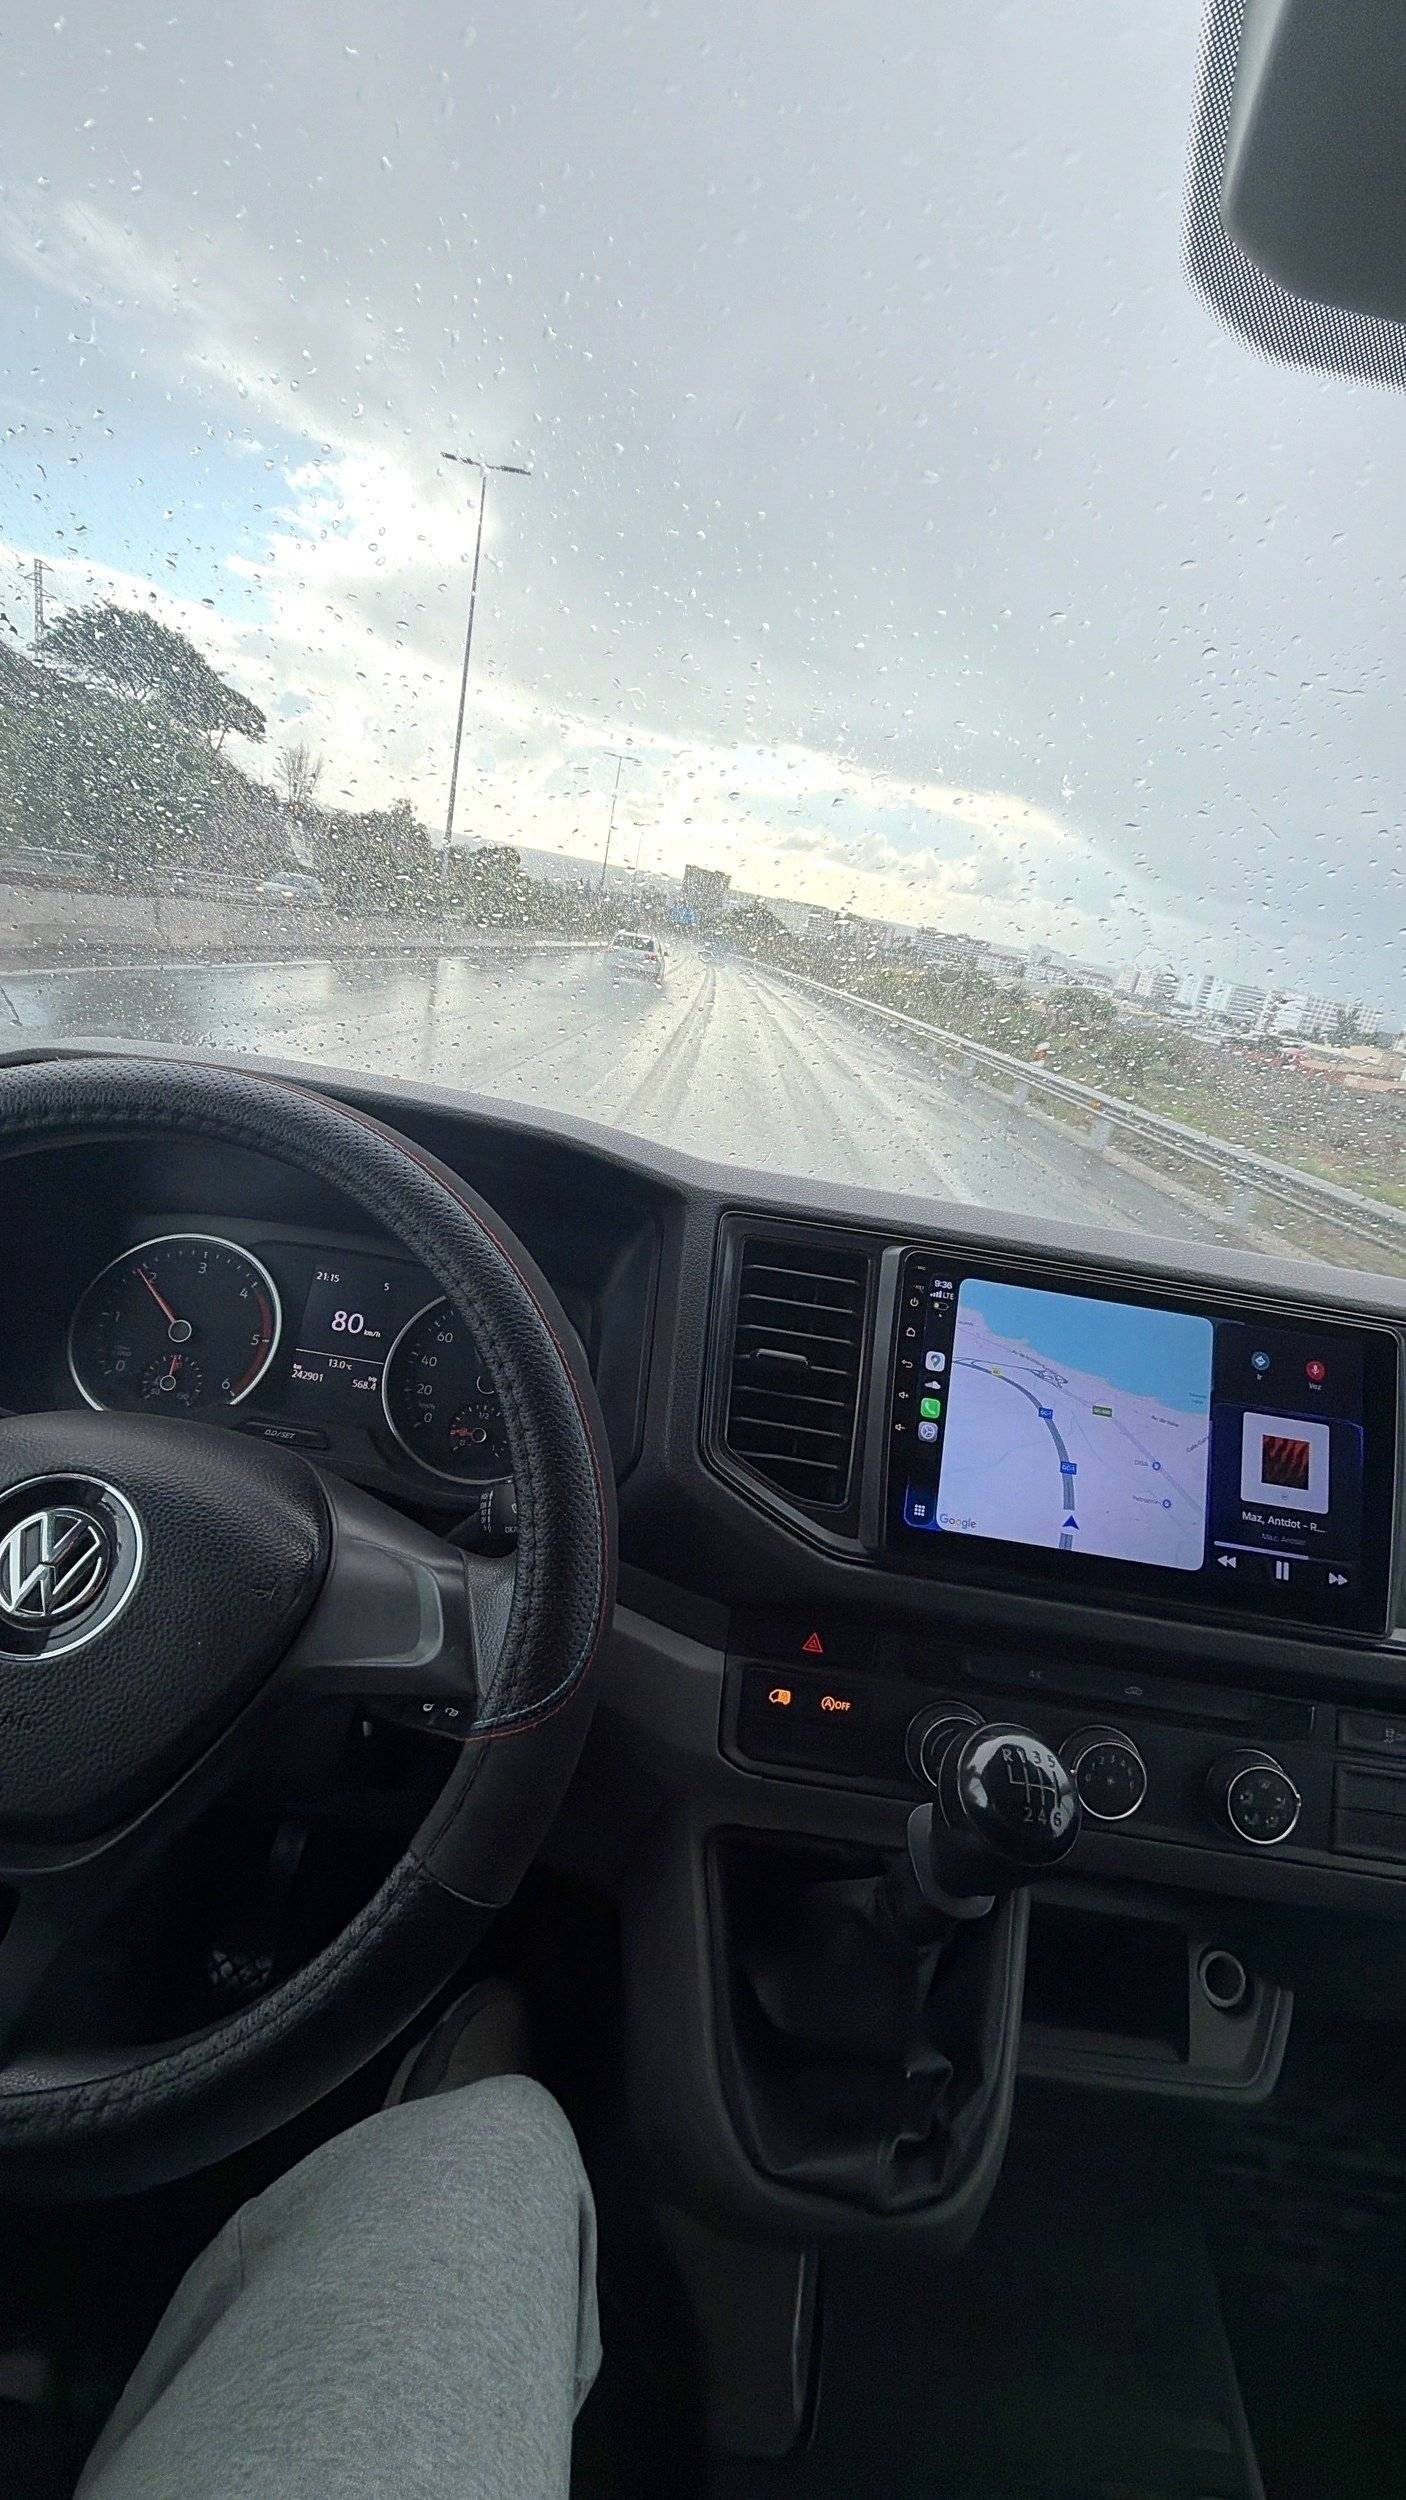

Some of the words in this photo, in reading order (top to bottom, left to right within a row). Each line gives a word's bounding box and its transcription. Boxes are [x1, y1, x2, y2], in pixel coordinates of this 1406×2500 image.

[198, 1262, 207, 1274] 3
[316, 1271, 340, 1283] 21:15
[384, 1282, 390, 1291] 5
[934, 1280, 953, 1290] 9:36
[239, 1288, 249, 1300] 4
[943, 1292, 955, 1300] LTE
[331, 1310, 364, 1334] 80
[364, 1329, 381, 1338] km/h
[250, 1334, 260, 1346] 5
[437, 1331, 454, 1344] 60
[115, 1359, 125, 1372] 0
[421, 1355, 438, 1368] 40
[291, 1369, 324, 1383] 242901
[221, 1378, 231, 1390] 6
[352, 1379, 377, 1391] 568.4
[417, 1383, 434, 1396] 20
[424, 1412, 433, 1424] 0
[940, 1513, 976, 1529] Google
[1242, 1511, 1265, 1525] Maz,
[1267, 1516, 1301, 1529] Antdot
[835, 1701, 851, 1711] OFF
[1002, 1748, 1013, 1762] R
[1016, 1748, 1026, 1763] 1
[1032, 1750, 1041, 1764] 3
[1047, 1754, 1056, 1768] 5
[1024, 1806, 1033, 1822] 2
[1038, 1808, 1047, 1825] 4
[1054, 1812, 1062, 1827] 6
